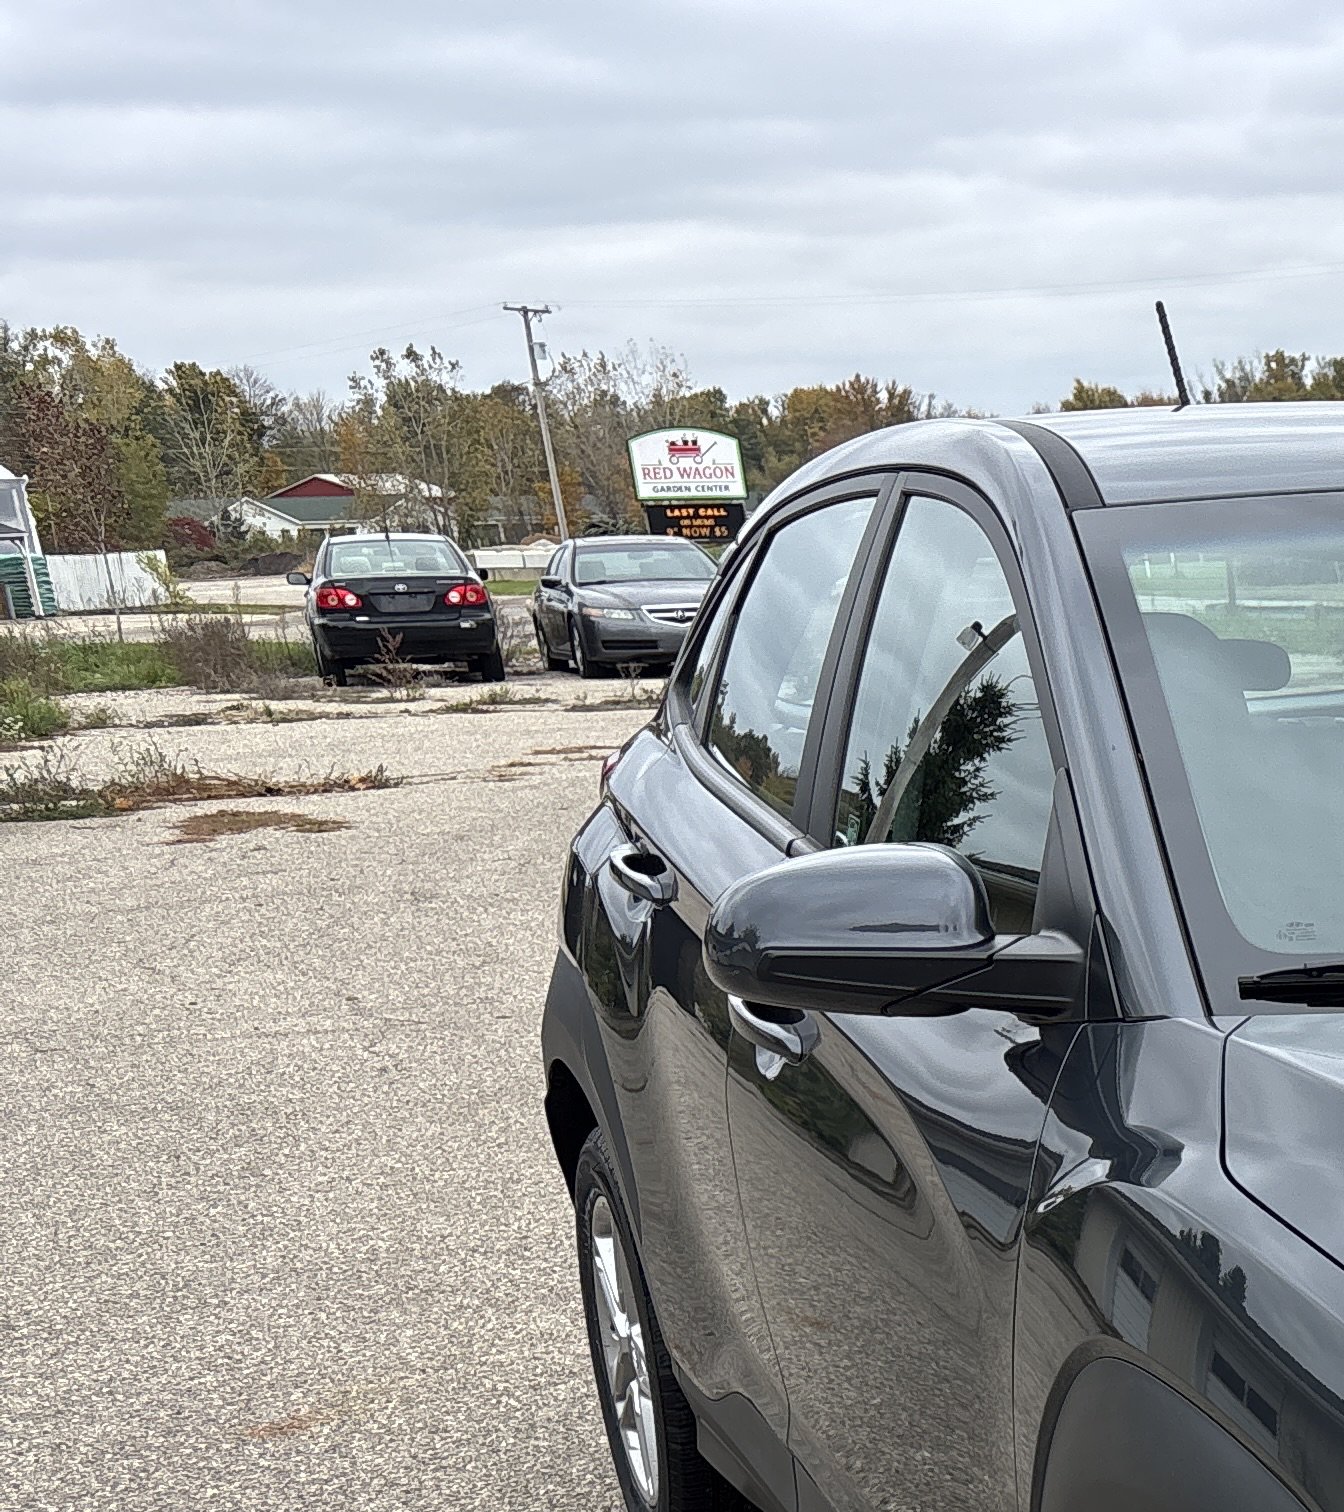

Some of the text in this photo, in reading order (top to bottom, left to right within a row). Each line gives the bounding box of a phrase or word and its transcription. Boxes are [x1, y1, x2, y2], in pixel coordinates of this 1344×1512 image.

[641, 465, 736, 480] RED WAGON
[652, 484, 730, 493] GARDEN CENTER
[665, 507, 729, 517] LAST CALL
[682, 527, 710, 537] NOW
